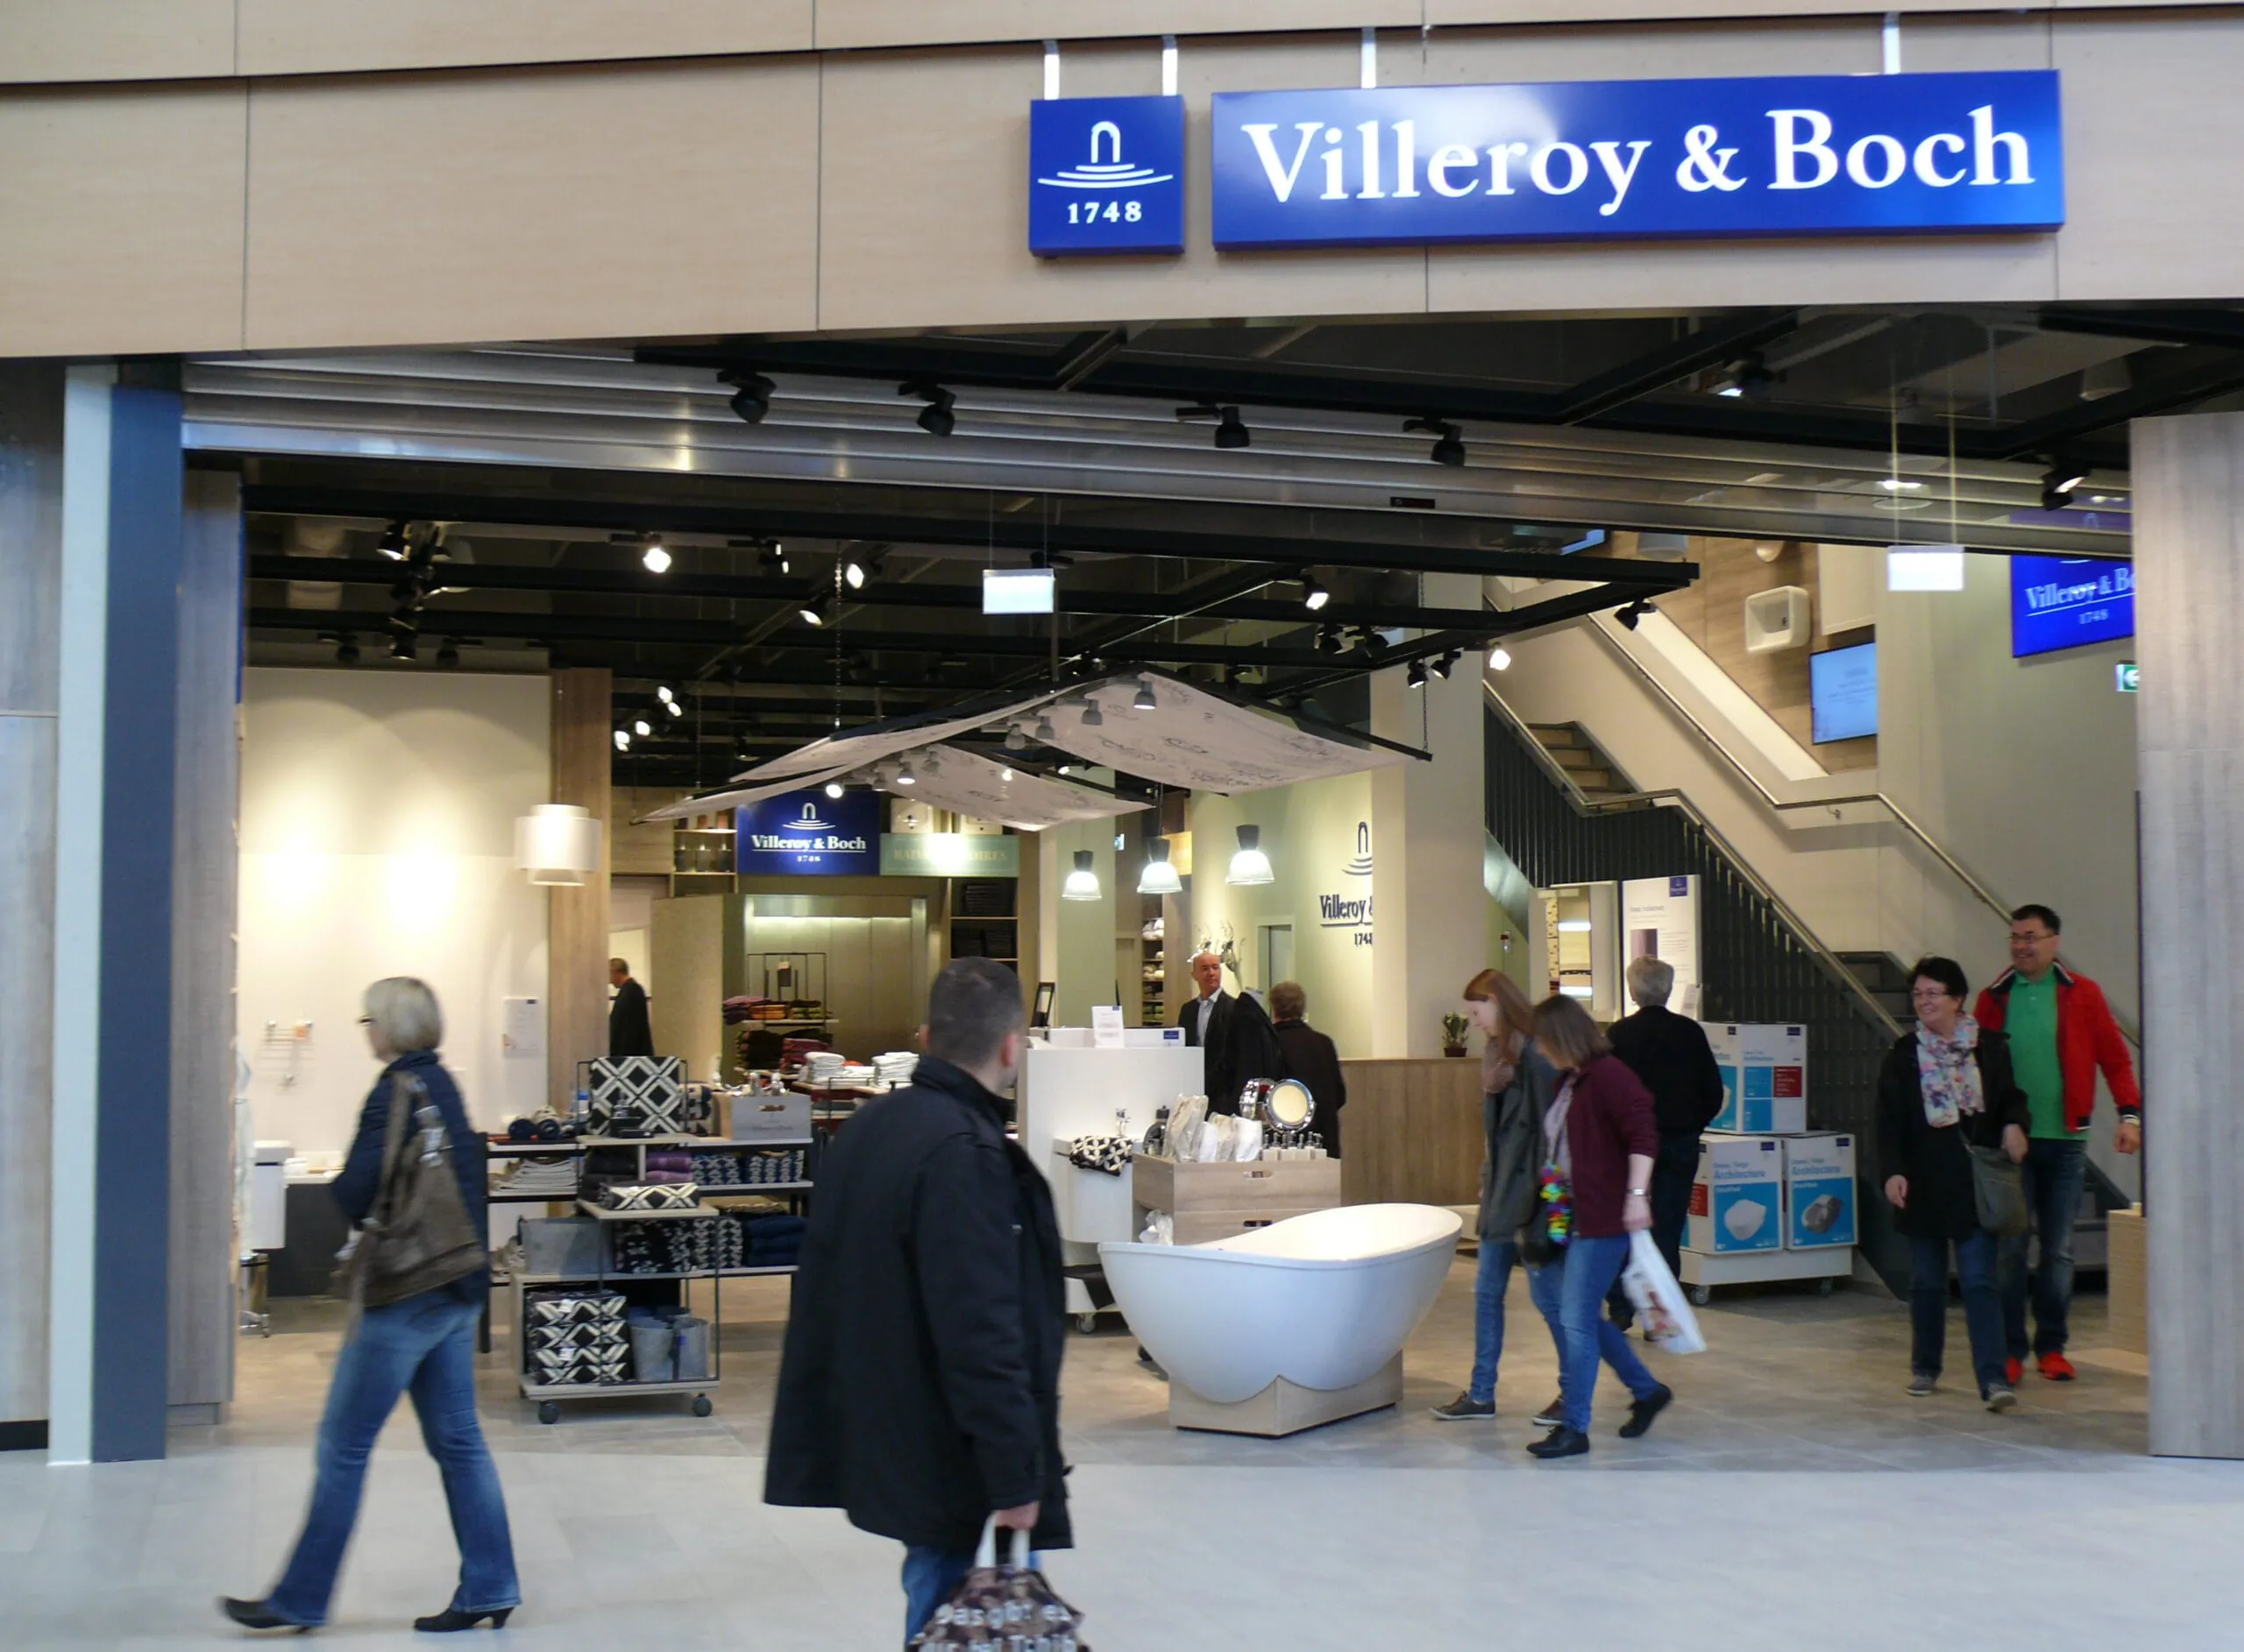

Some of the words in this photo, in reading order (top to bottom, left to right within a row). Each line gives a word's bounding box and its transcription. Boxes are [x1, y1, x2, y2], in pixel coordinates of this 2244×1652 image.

[1240, 120, 1652, 216] Villeroy
[1676, 124, 1748, 192] &
[1765, 104, 2036, 189] Boch
[1068, 201, 1142, 224] 1748
[2024, 582, 2097, 609] Villeroy
[2098, 575, 2113, 595] &
[751, 834, 812, 852] Villeroy
[813, 838, 825, 849] &
[827, 835, 866, 850] Boch
[1318, 894, 1367, 924] Villeroy
